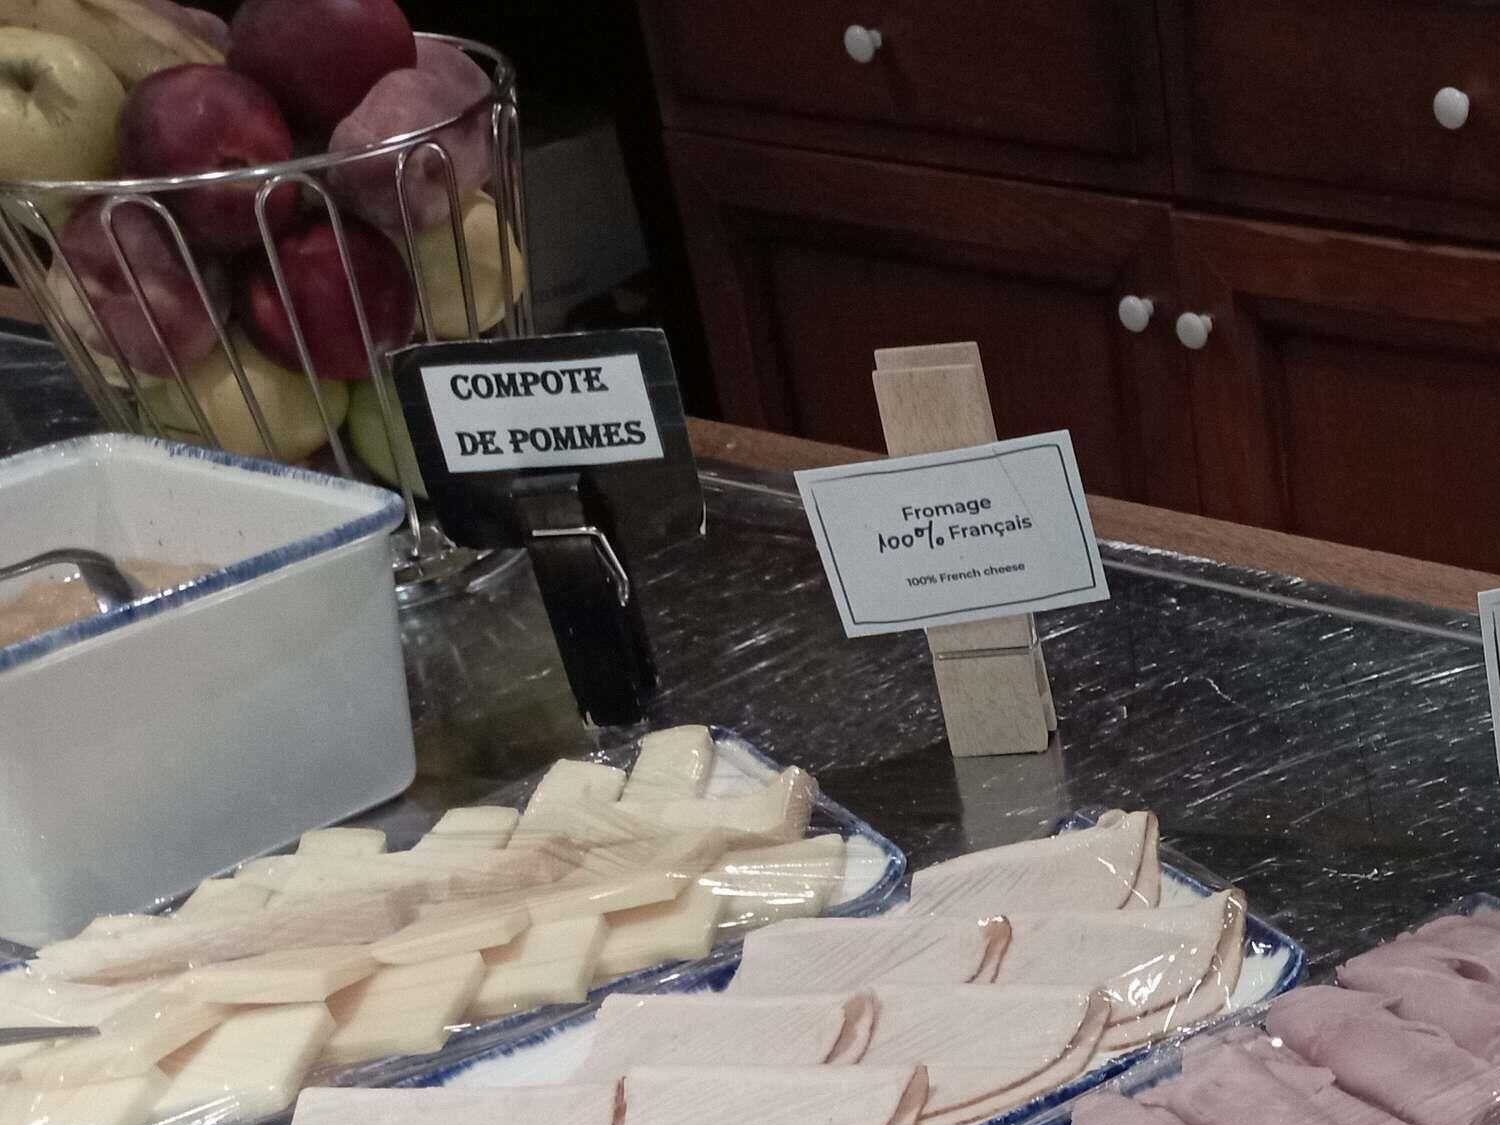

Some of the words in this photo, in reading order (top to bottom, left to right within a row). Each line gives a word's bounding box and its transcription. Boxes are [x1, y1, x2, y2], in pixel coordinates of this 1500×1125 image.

[450, 367, 609, 400] COMPOTE
[455, 430, 504, 456] DE
[508, 420, 647, 453] POMMES
[902, 497, 991, 521] Fromage
[878, 520, 945, 554] 100%
[949, 514, 1033, 540] Français
[906, 573, 938, 587] 100%
[939, 568, 981, 583] French
[984, 562, 1025, 576] cheese
